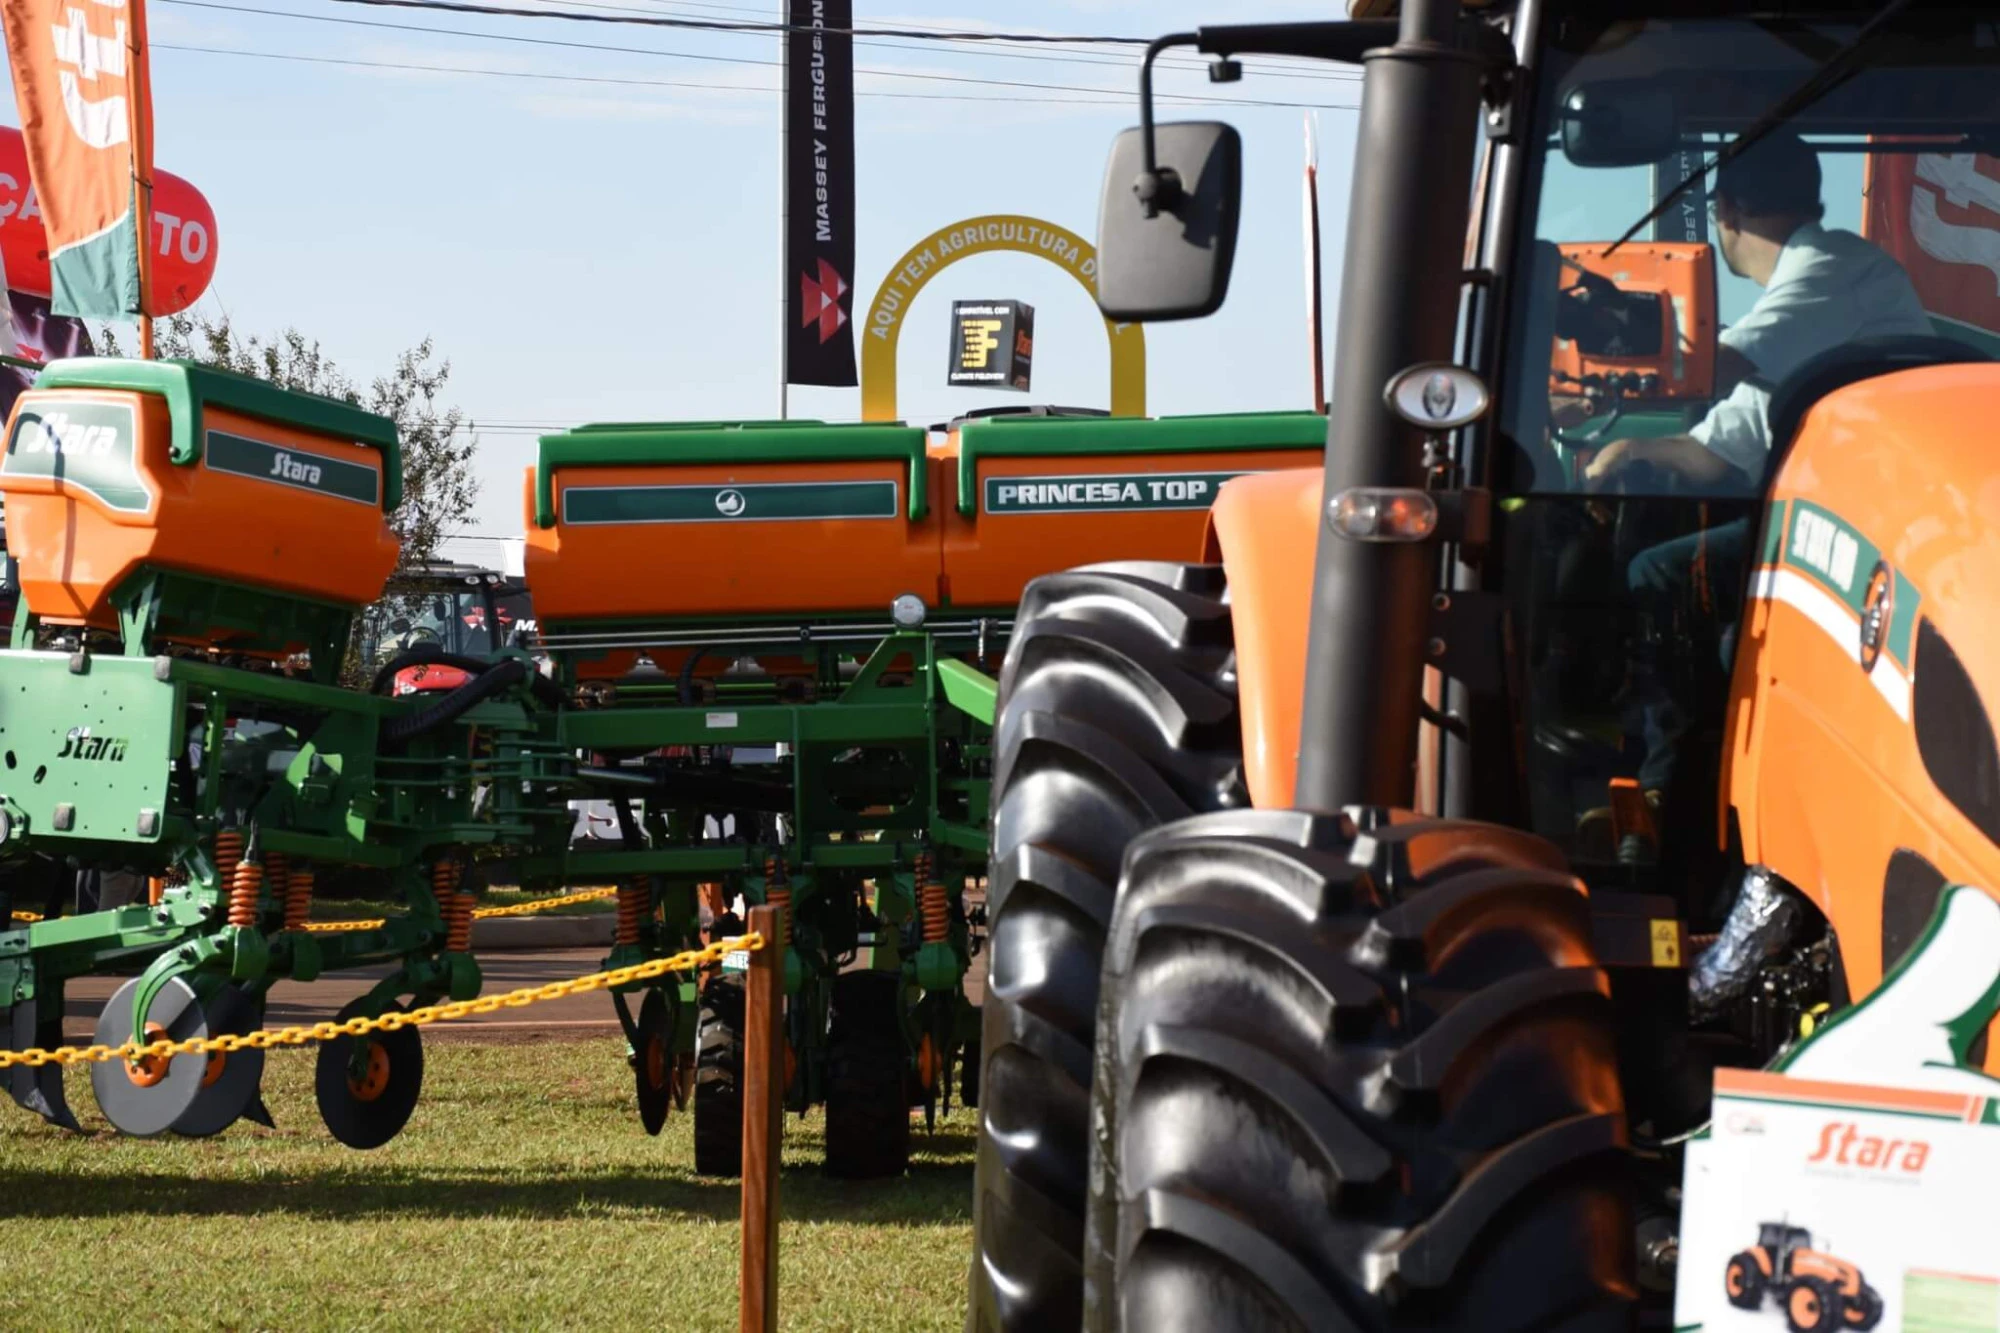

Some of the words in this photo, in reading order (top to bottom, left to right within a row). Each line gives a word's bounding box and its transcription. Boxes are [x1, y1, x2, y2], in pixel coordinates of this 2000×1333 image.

[811, 0, 827, 131] FERGUSON
[814, 139, 831, 241] MASSEY
[870, 288, 904, 339] AQUI
[896, 249, 936, 288] TEM
[937, 222, 1080, 266] AGRICULTURA
[26, 412, 118, 455] Stara
[270, 452, 322, 484] Stara
[998, 482, 1143, 505] PRINCESA
[1148, 480, 1208, 501] TOP
[57, 726, 130, 762] Stara
[1808, 1121, 1931, 1173] Stara
